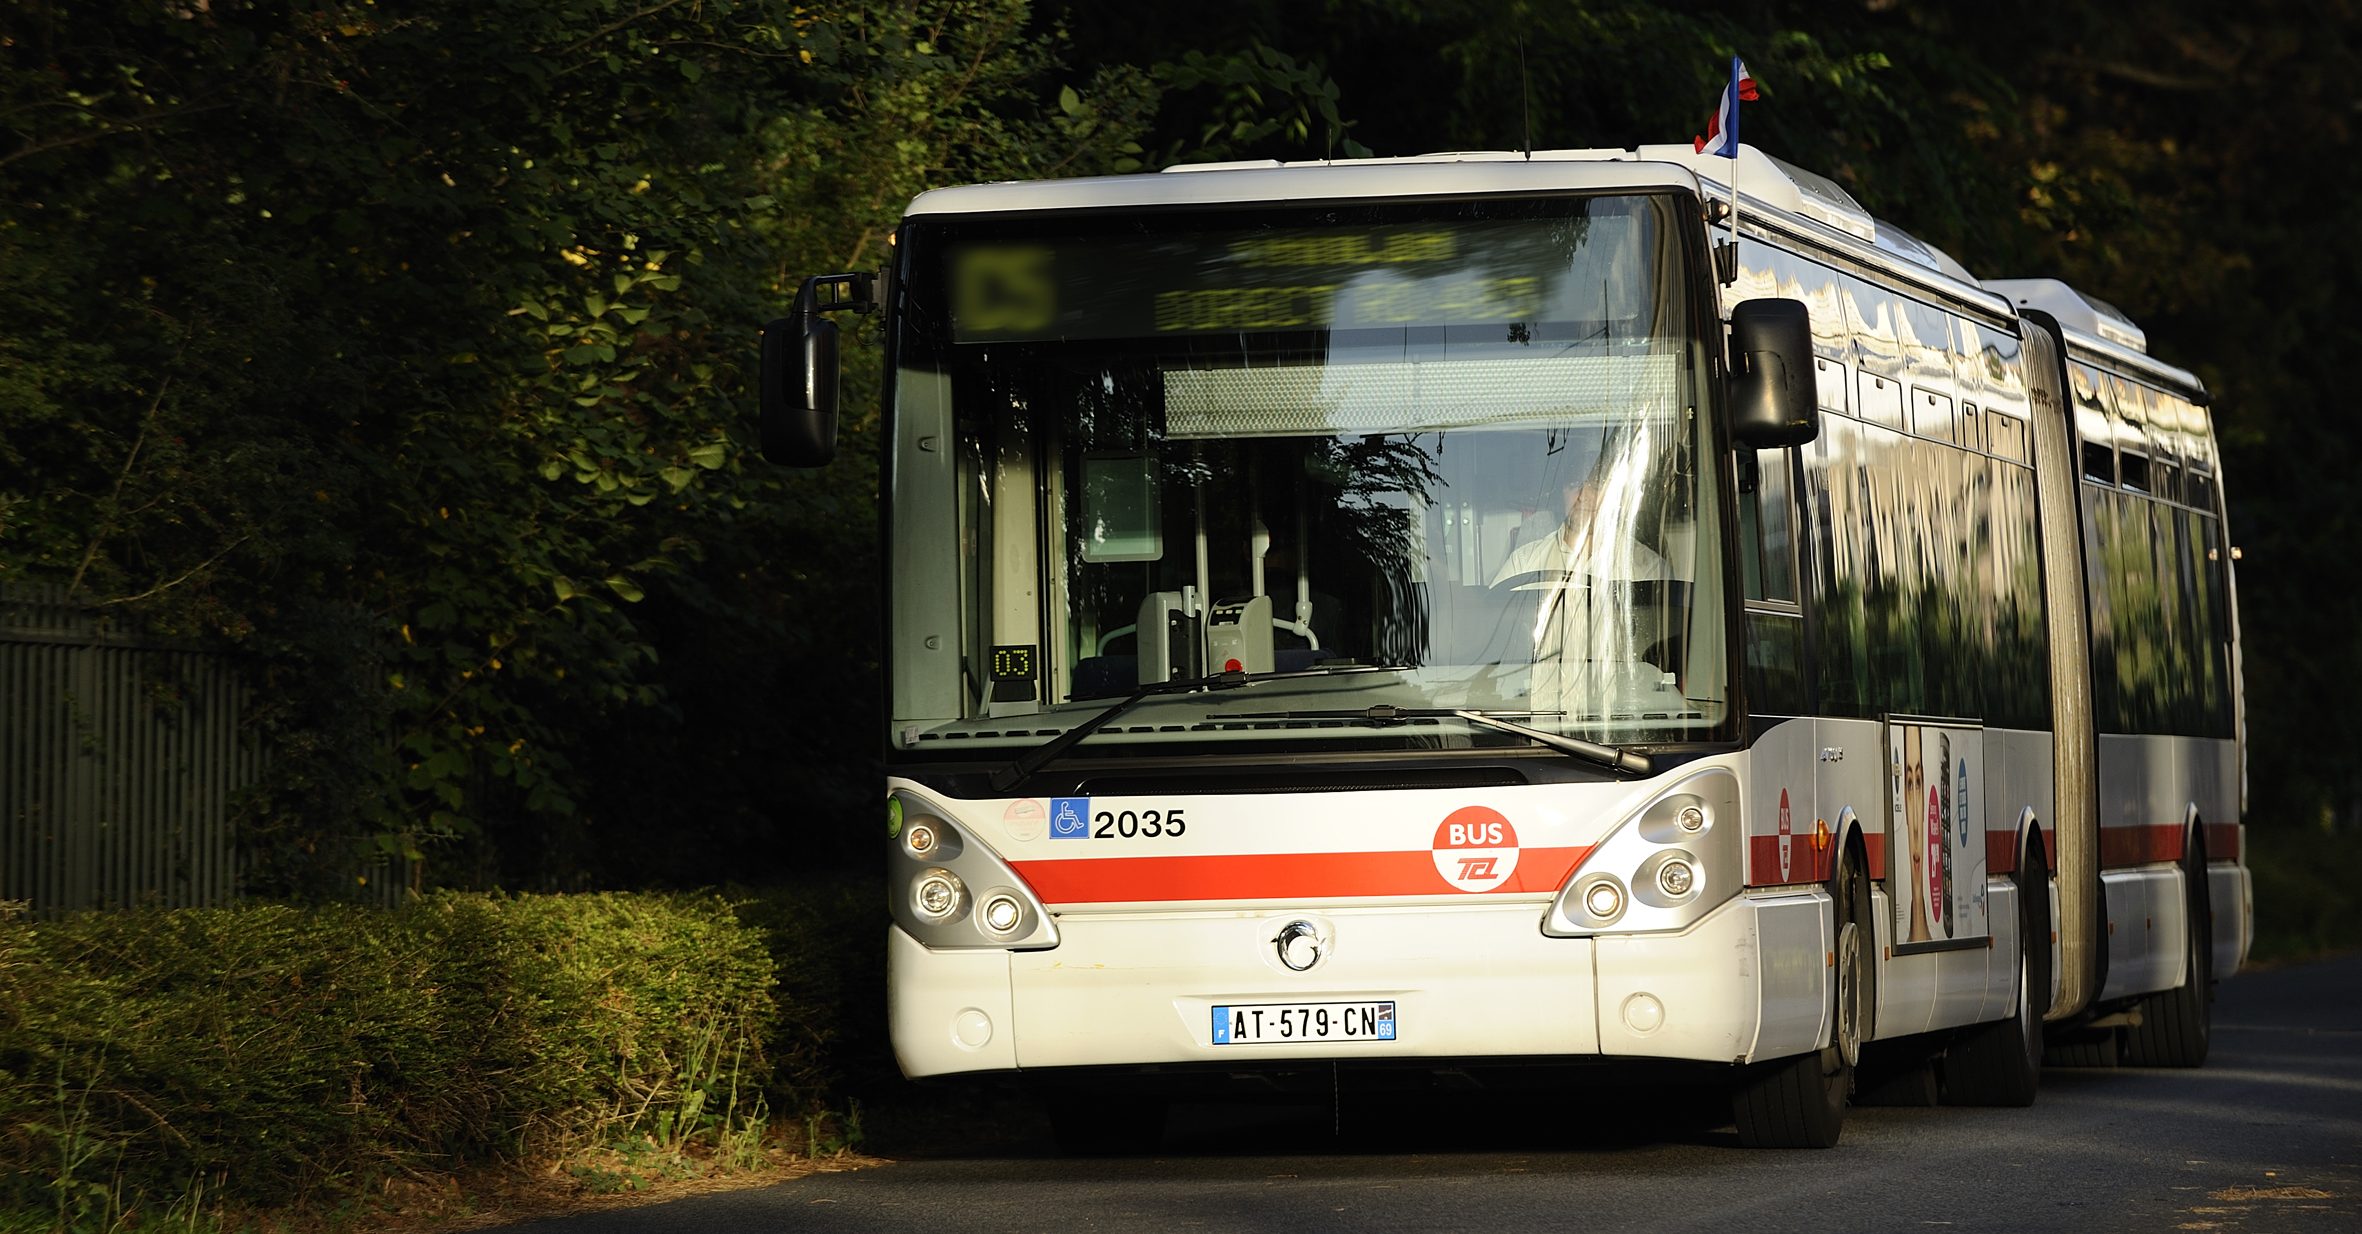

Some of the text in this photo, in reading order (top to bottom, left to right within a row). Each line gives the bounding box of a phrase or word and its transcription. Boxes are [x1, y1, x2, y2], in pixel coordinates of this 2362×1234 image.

[995, 649, 1029, 676] 03
[1094, 809, 1186, 838] 2035
[1449, 822, 1504, 846] BUS
[1457, 857, 1499, 880] TCL
[1218, 1007, 1393, 1039] F AT-579-CN 69
